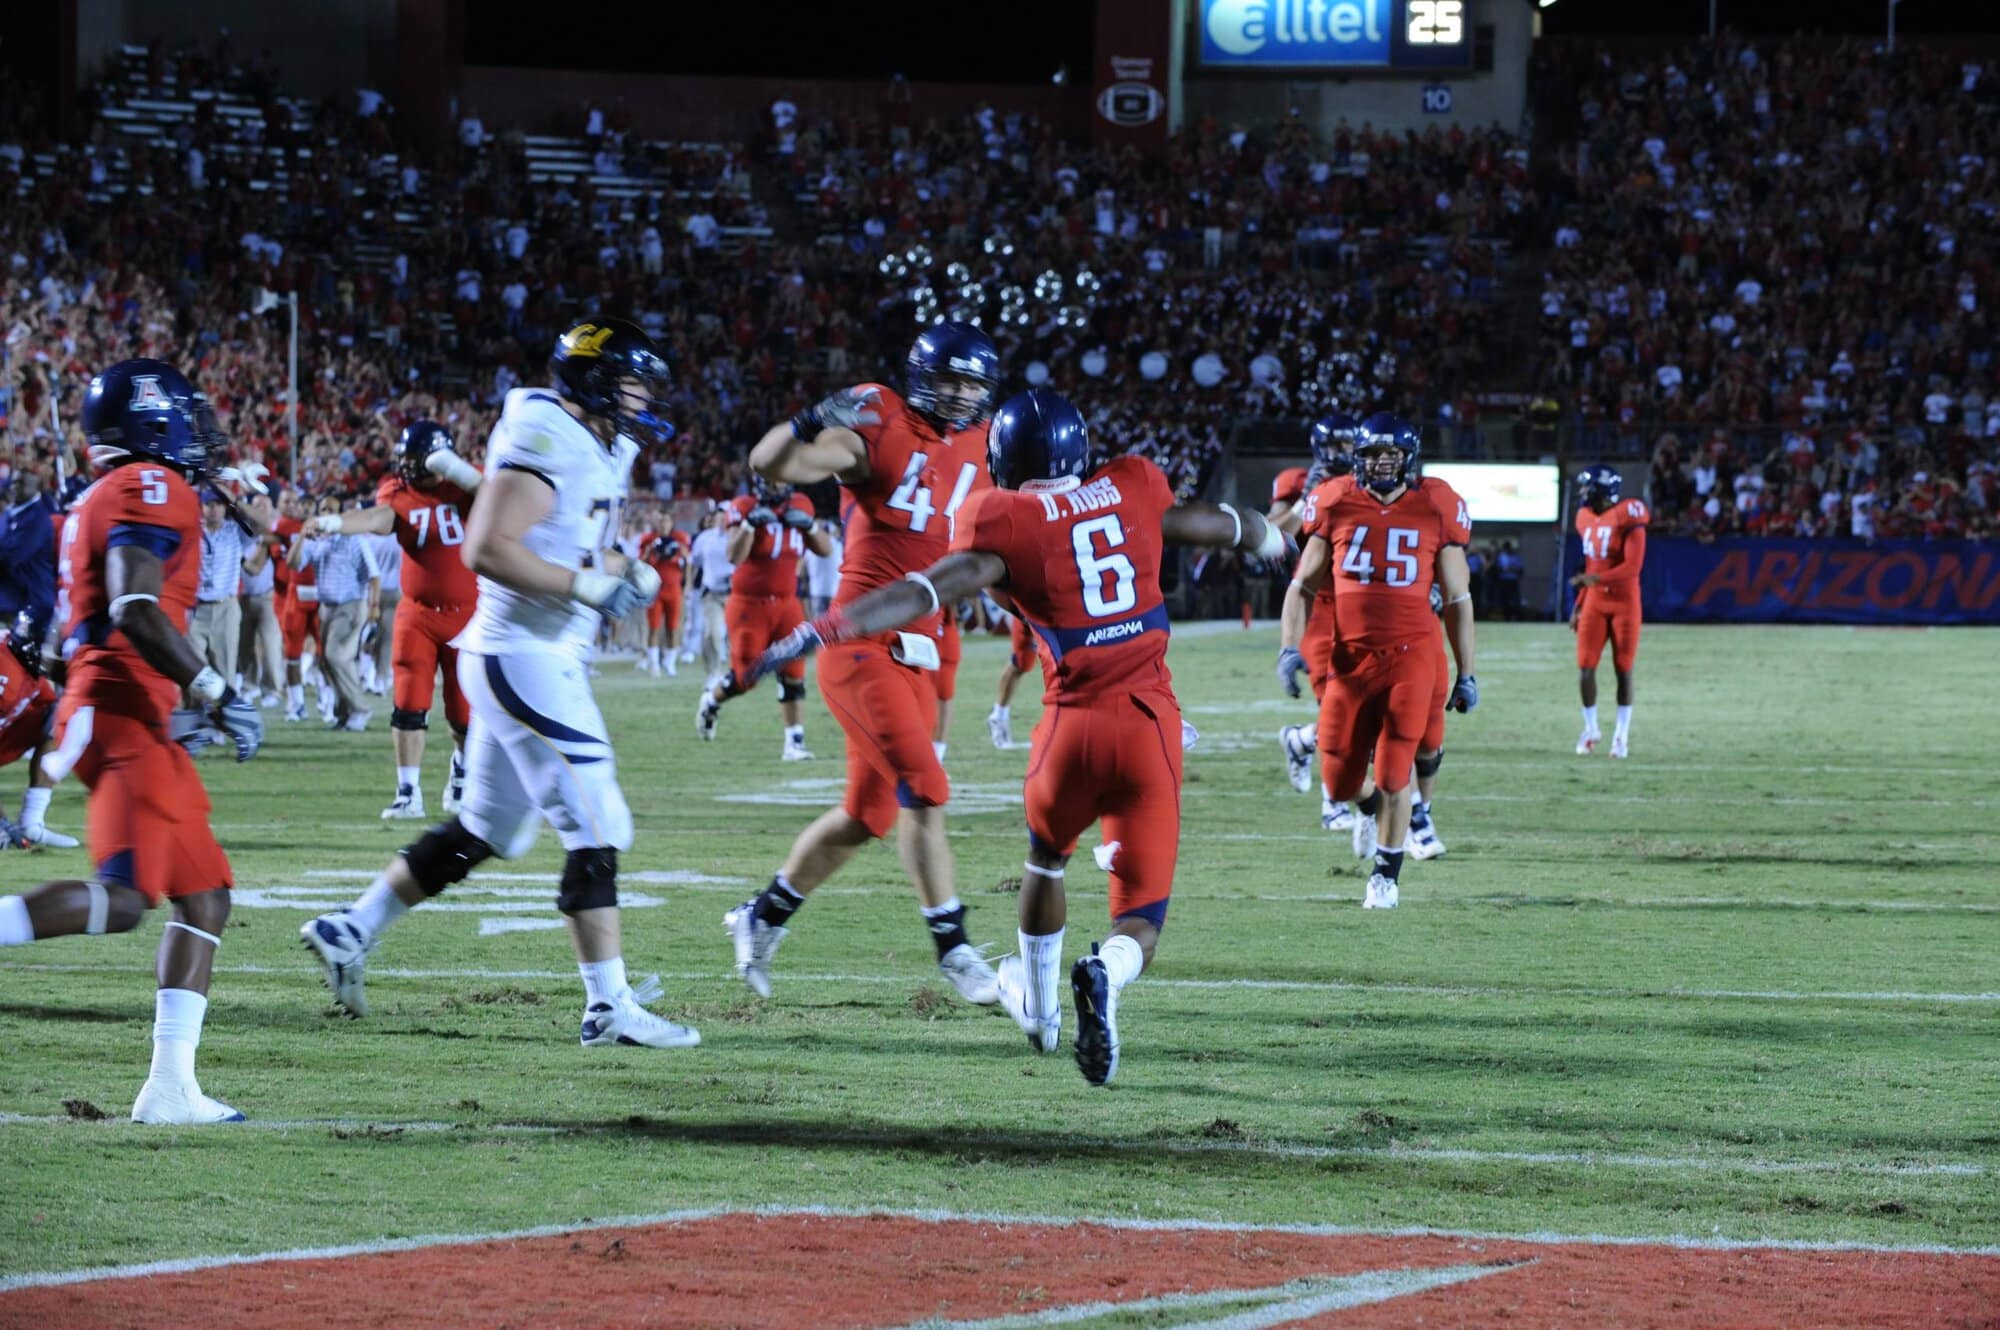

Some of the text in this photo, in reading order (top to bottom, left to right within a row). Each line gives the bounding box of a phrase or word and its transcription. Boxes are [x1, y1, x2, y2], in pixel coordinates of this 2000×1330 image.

[1222, 0, 1382, 46] alltel
[1408, 0, 1462, 43] 25
[1424, 90, 1450, 110] 10
[130, 375, 174, 411] A
[139, 468, 168, 504] 5
[409, 504, 465, 548] 78
[1583, 526, 1612, 559] 47
[1072, 513, 1137, 618] 6
[1341, 526, 1419, 587] 45
[1689, 550, 2000, 609] ARIZON
[1085, 620, 1144, 646] ARIZONA
